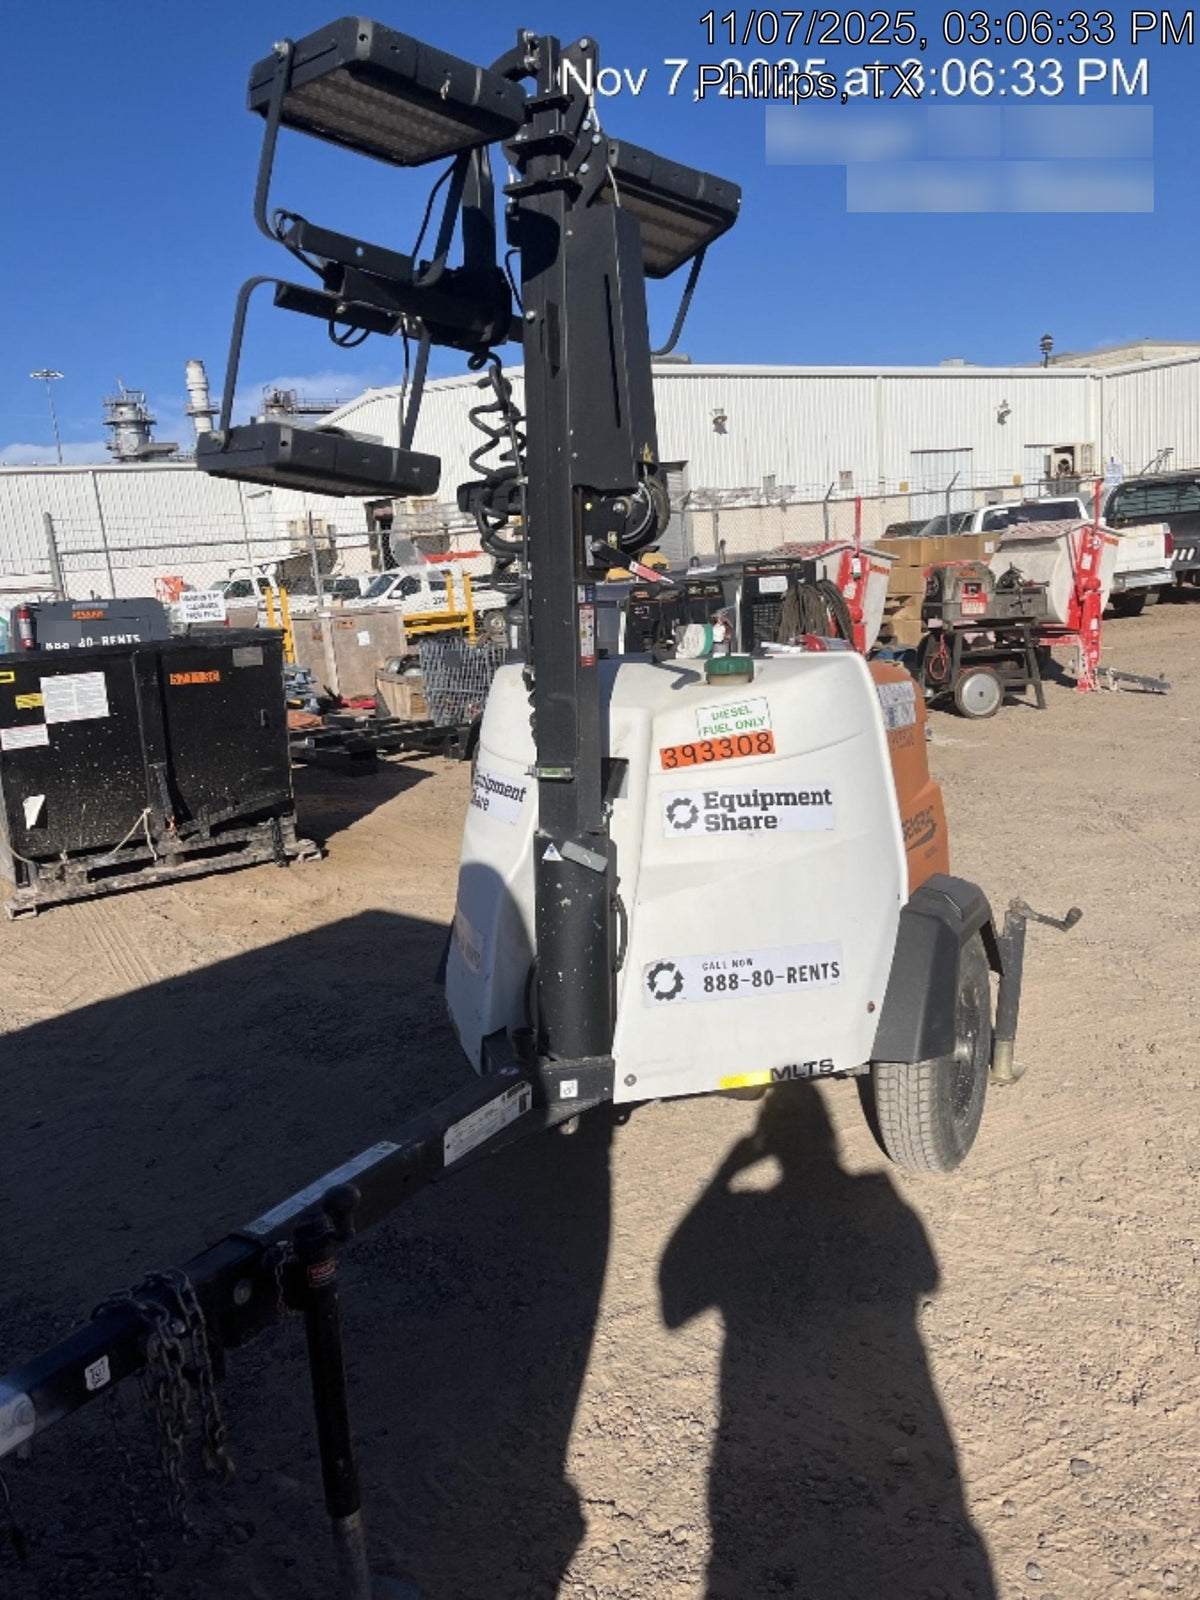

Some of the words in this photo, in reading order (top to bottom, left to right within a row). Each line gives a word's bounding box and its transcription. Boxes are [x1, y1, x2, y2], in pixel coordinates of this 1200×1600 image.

[711, 705, 753, 721] DIESEL
[703, 722, 733, 737] FUEL
[735, 716, 767, 730] ONLY
[664, 731, 773, 769] 393308
[703, 788, 833, 813] Equipment
[704, 812, 778, 832] Share
[702, 961, 727, 971] CALL
[732, 957, 754, 968] NOW
[703, 961, 841, 993] 888-80-RENTS
[769, 1058, 835, 1082] MLTS
